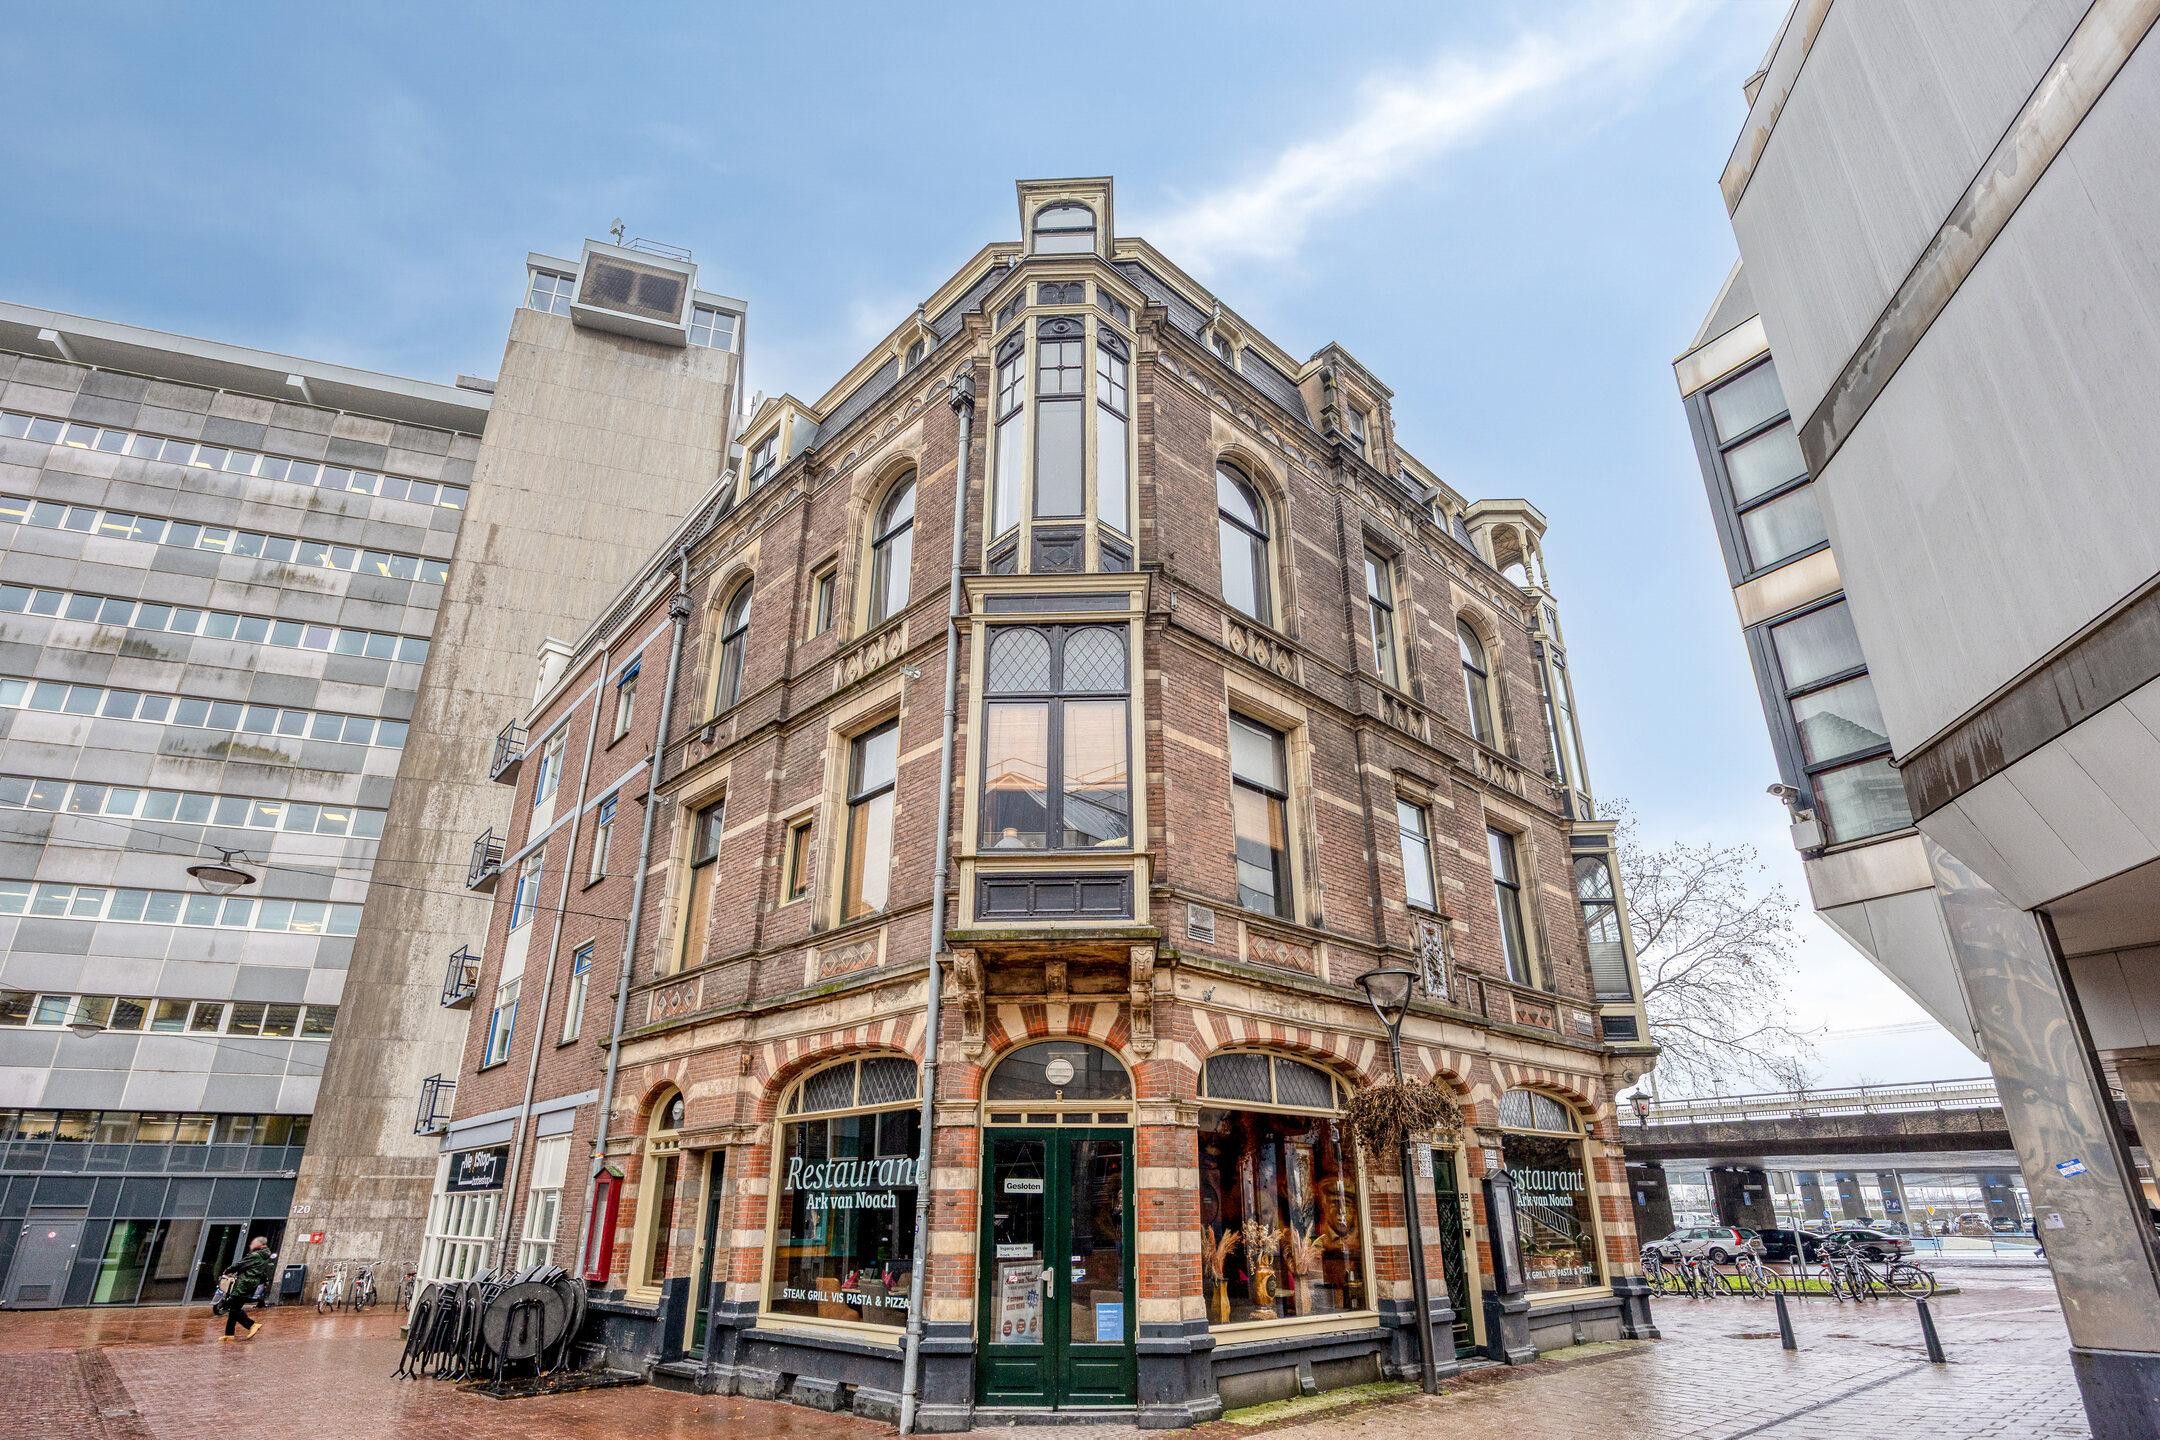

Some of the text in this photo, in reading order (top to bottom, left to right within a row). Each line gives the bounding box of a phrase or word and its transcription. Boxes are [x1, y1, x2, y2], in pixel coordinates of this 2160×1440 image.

[785, 1157, 921, 1190] Restaurant
[1504, 1163, 1584, 1191] estaurant
[1006, 1182, 1041, 1190] Gesloten
[806, 1190, 896, 1210] Ark van Noach
[1517, 1192, 1574, 1207] Ark van Noach
[292, 1205, 311, 1214] 120
[1532, 1271, 1547, 1279] GRILL
[1548, 1269, 1556, 1278] VIS
[1557, 1268, 1573, 1276] PASTA
[1574, 1267, 1579, 1275] &
[1580, 1266, 1593, 1274] PIZZA
[783, 1288, 909, 1309] STEAK GRILL VIS PASTA & PIZZA
